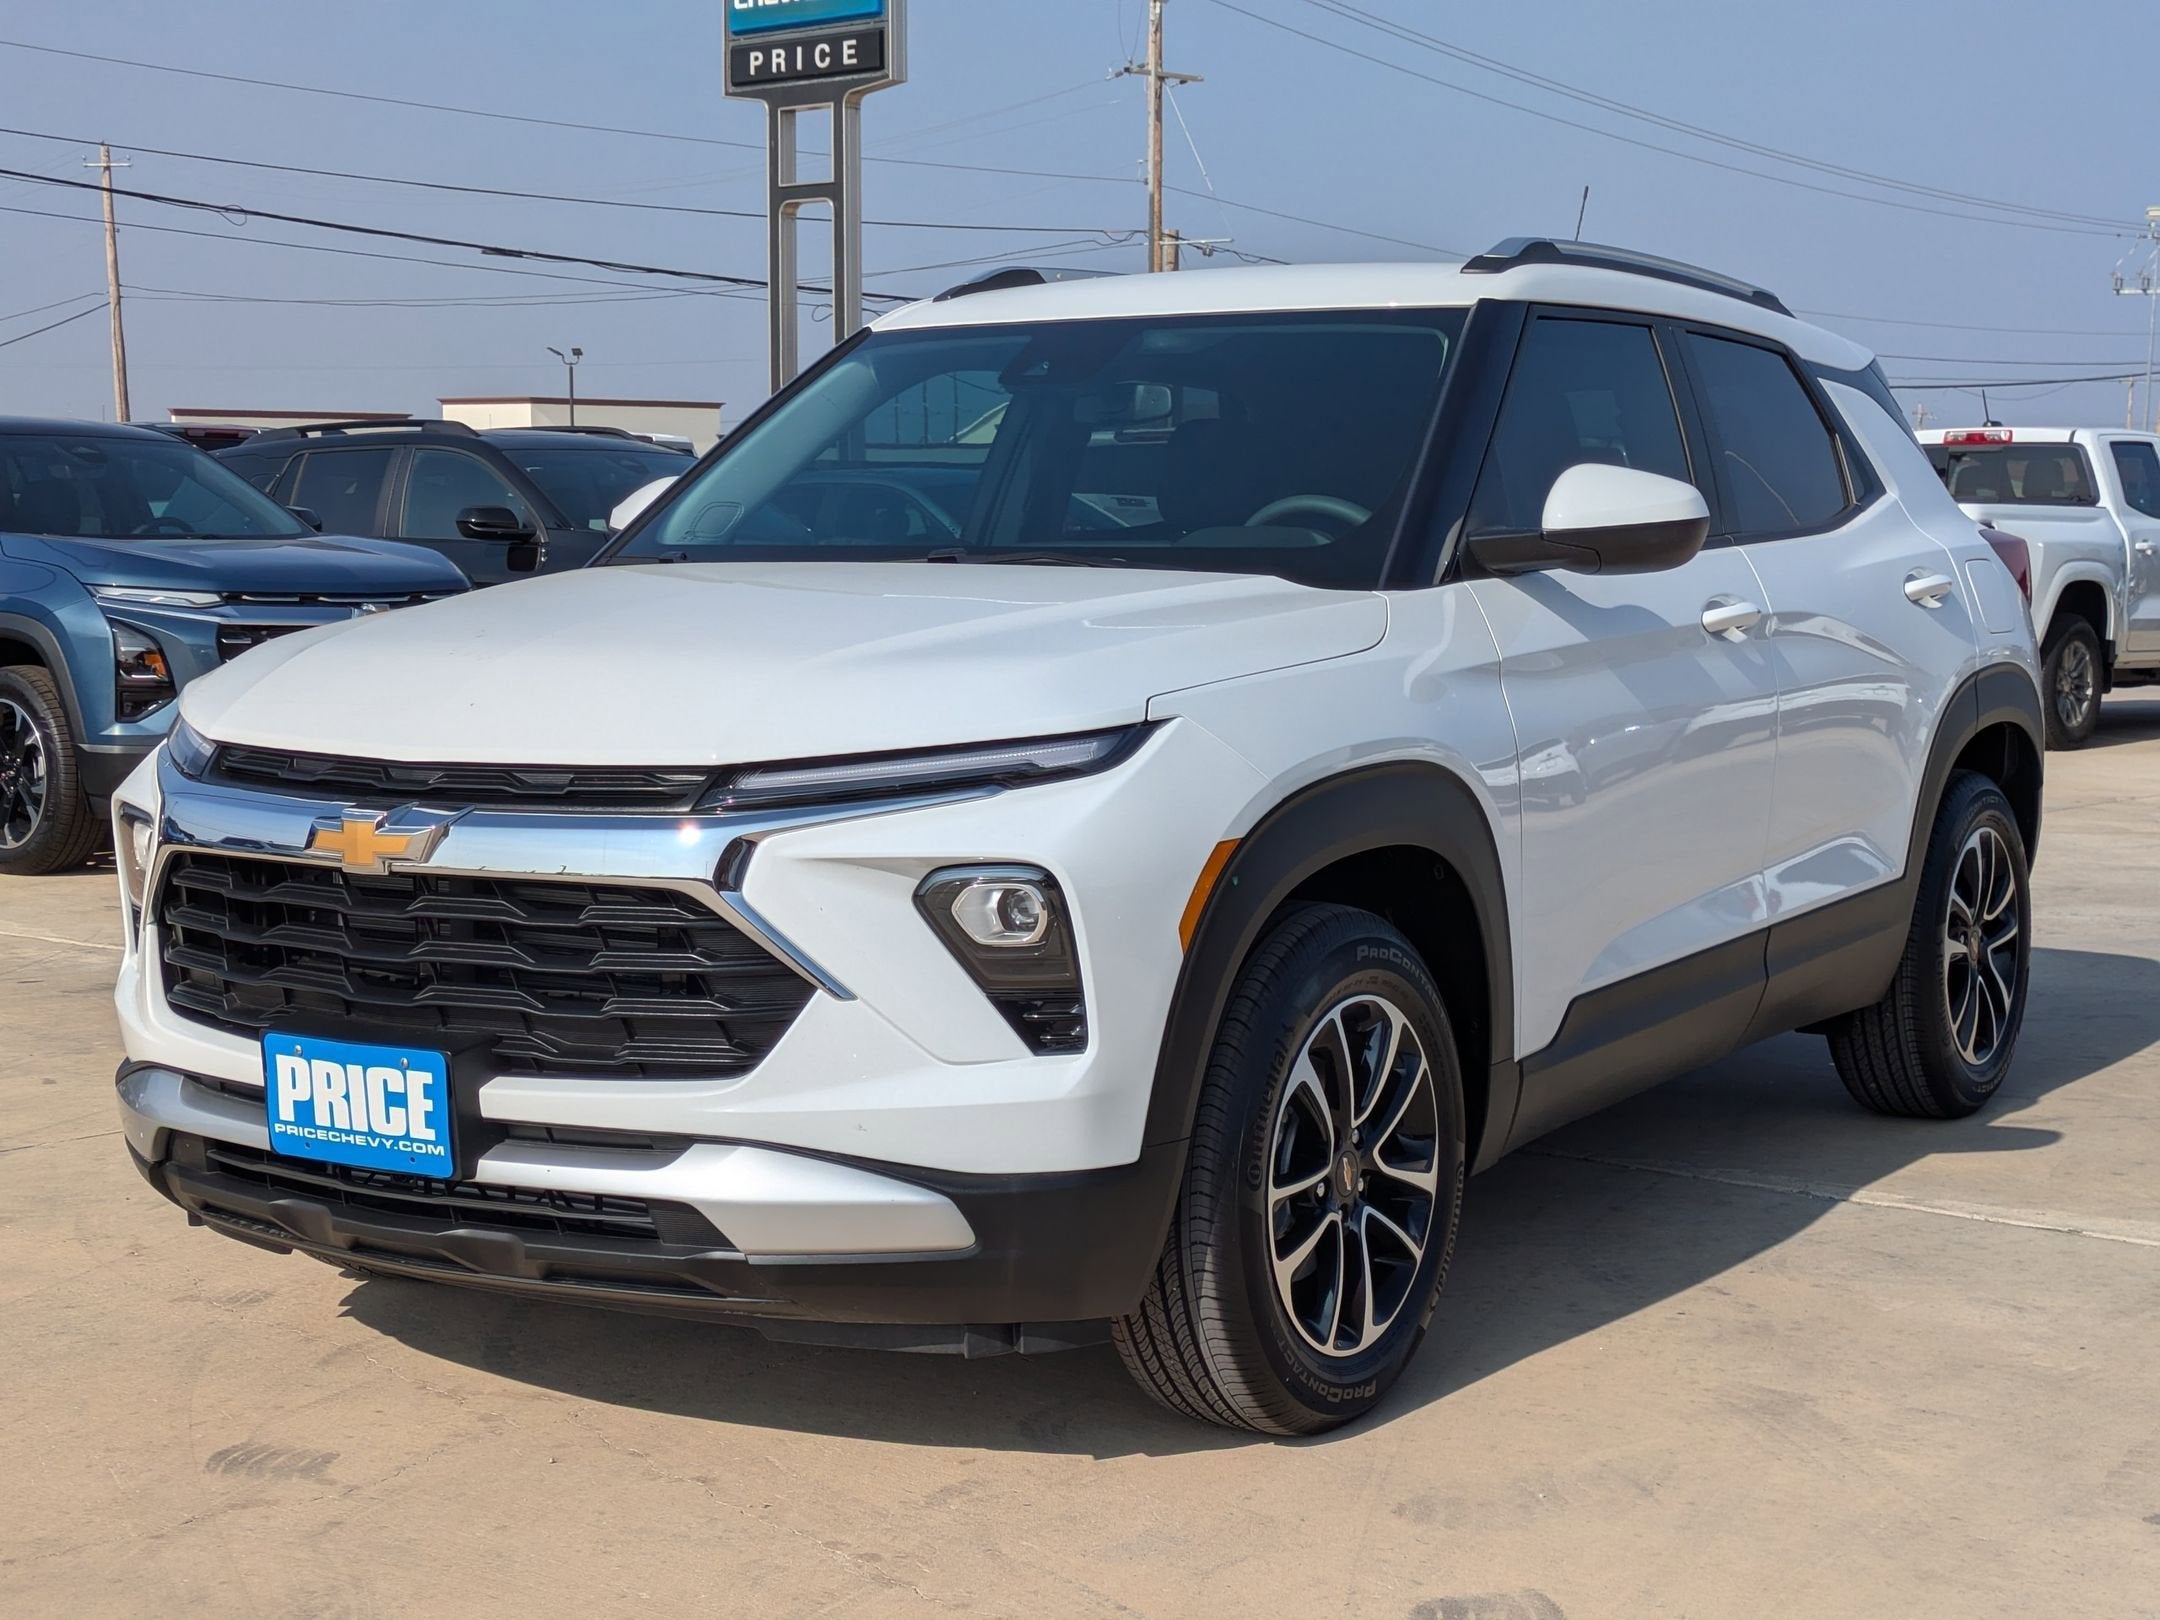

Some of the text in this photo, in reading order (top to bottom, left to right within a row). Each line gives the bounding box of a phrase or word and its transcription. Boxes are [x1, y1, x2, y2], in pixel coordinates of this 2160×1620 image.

[749, 39, 858, 76] PRICE
[275, 1054, 436, 1141] PRICE
[274, 1123, 445, 1156] PRICECHEVY.COM
